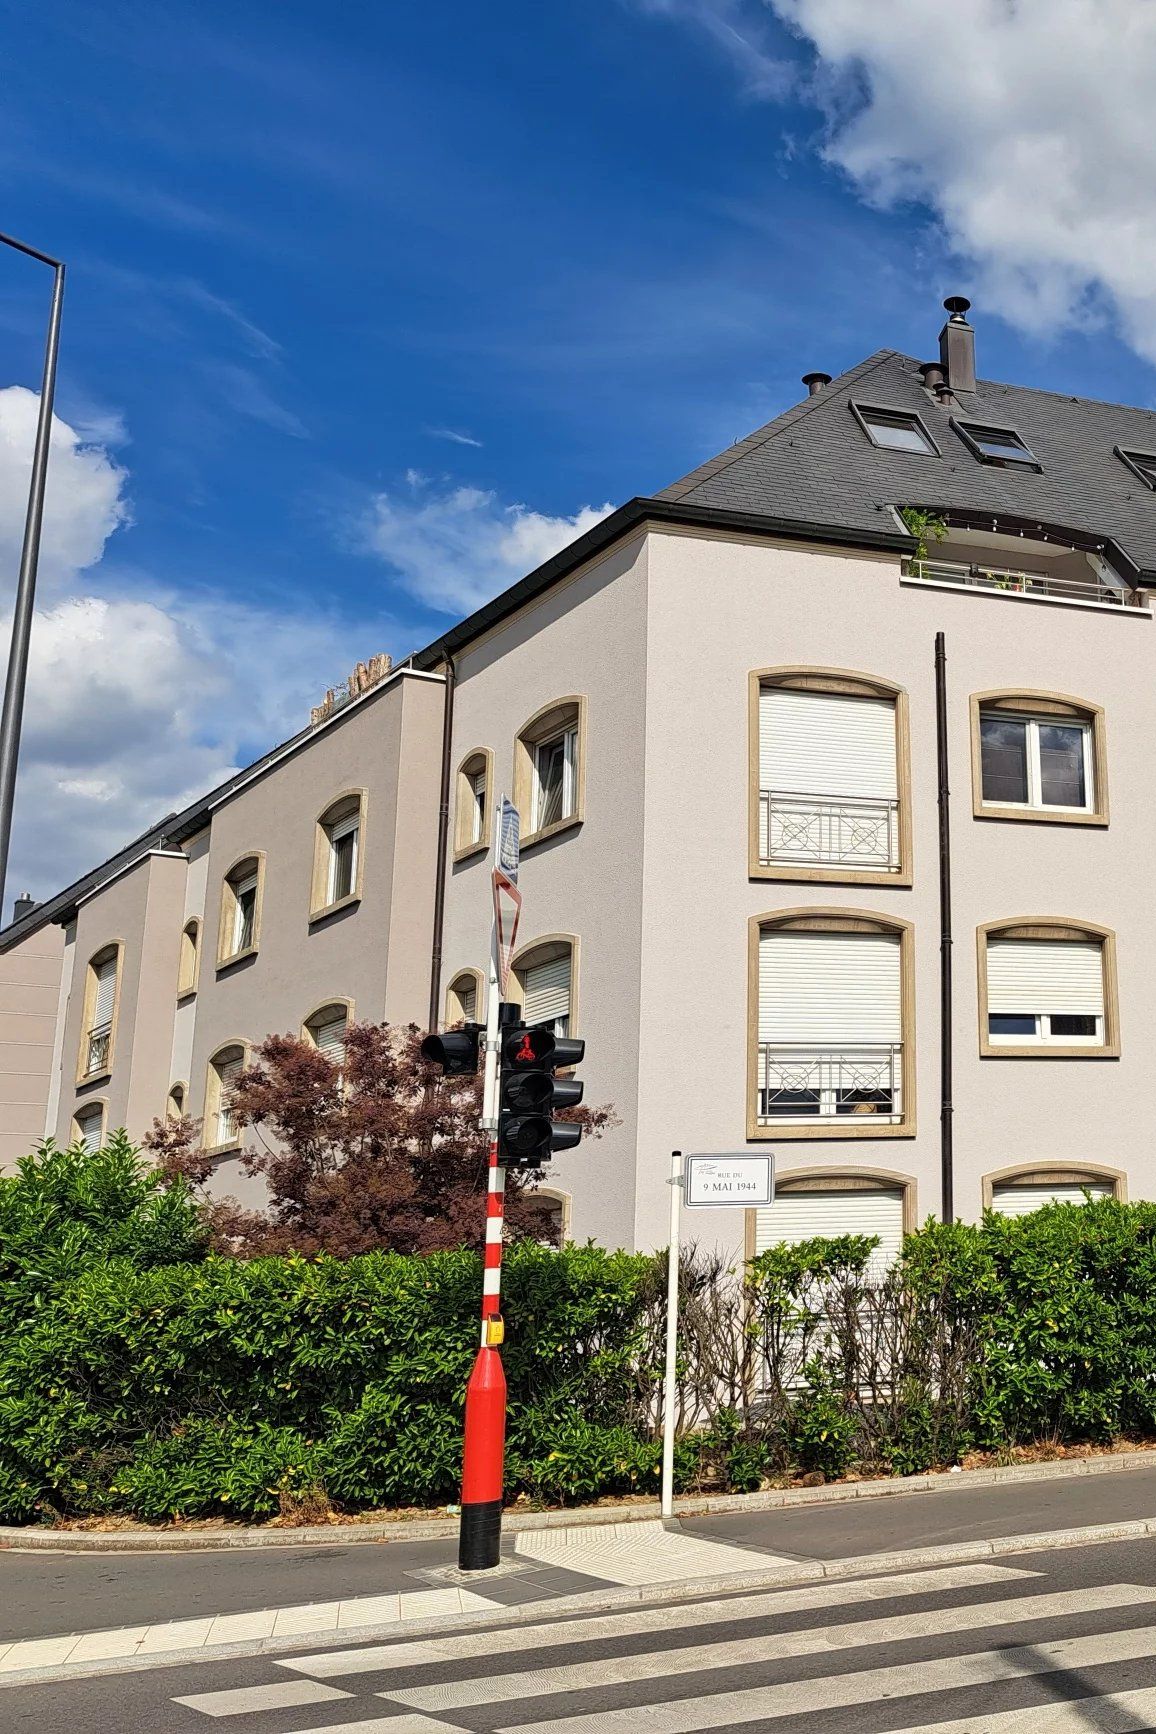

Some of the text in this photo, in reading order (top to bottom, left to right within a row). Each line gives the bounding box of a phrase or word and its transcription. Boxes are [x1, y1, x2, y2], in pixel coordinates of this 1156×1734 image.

[703, 1182, 756, 1191] 9 MAI 1944
